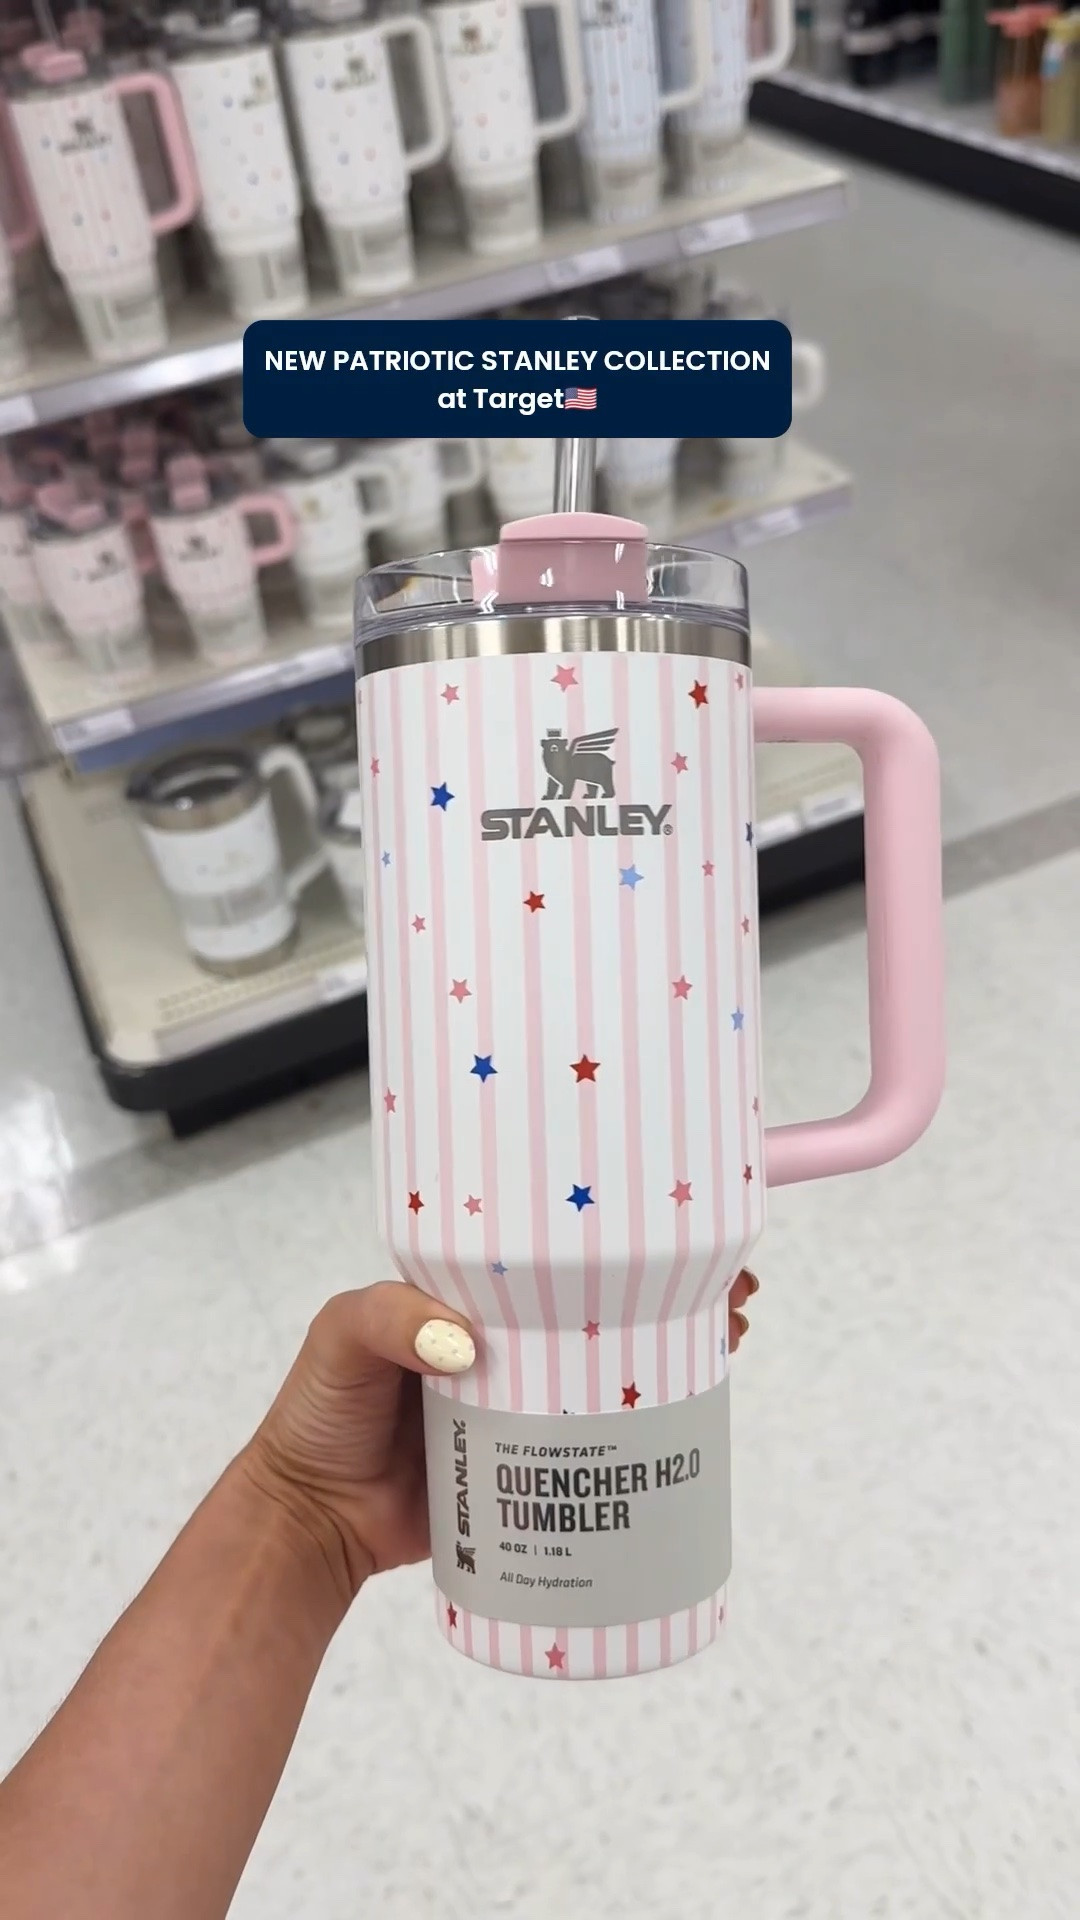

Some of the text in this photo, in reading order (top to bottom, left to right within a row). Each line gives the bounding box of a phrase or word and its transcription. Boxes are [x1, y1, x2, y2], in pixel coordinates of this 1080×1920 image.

[494, 1441, 520, 1456] THE
[496, 1447, 701, 1498] QUENCHER H2.0
[496, 1497, 631, 1534] TUMBLER
[498, 1541, 573, 1557] 40 OZ 1.18 L
[499, 1571, 594, 1590] All Day Hydration
